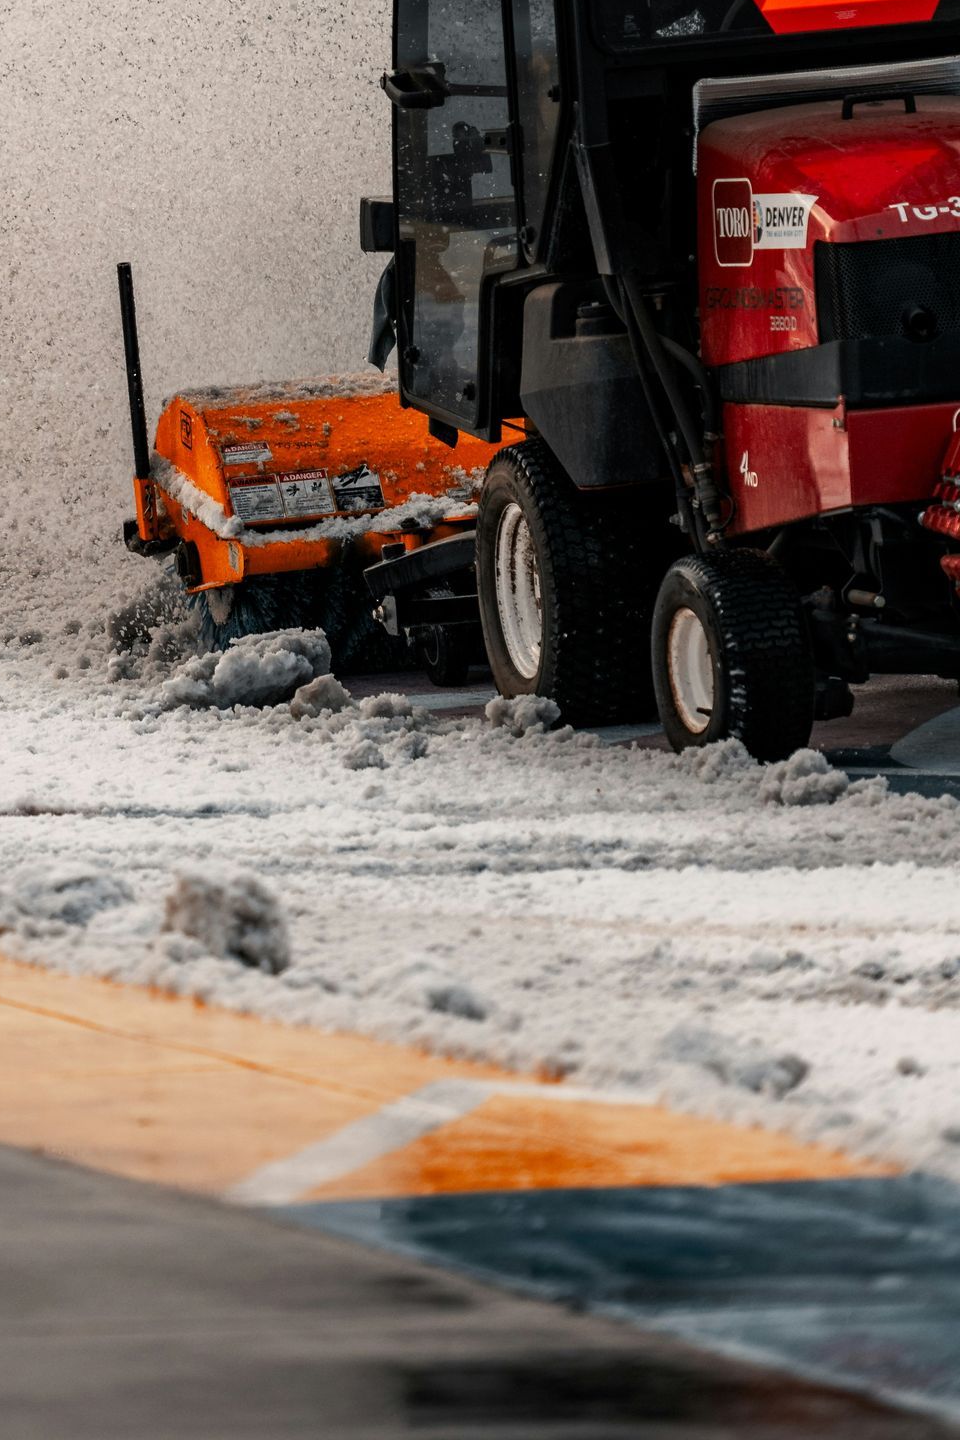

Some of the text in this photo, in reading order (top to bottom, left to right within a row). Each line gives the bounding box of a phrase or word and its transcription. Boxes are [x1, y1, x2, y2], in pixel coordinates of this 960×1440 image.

[717, 207, 750, 238] TORO
[765, 207, 804, 227] DENVER
[230, 443, 264, 452] DANGER
[289, 471, 323, 481] DANGER
